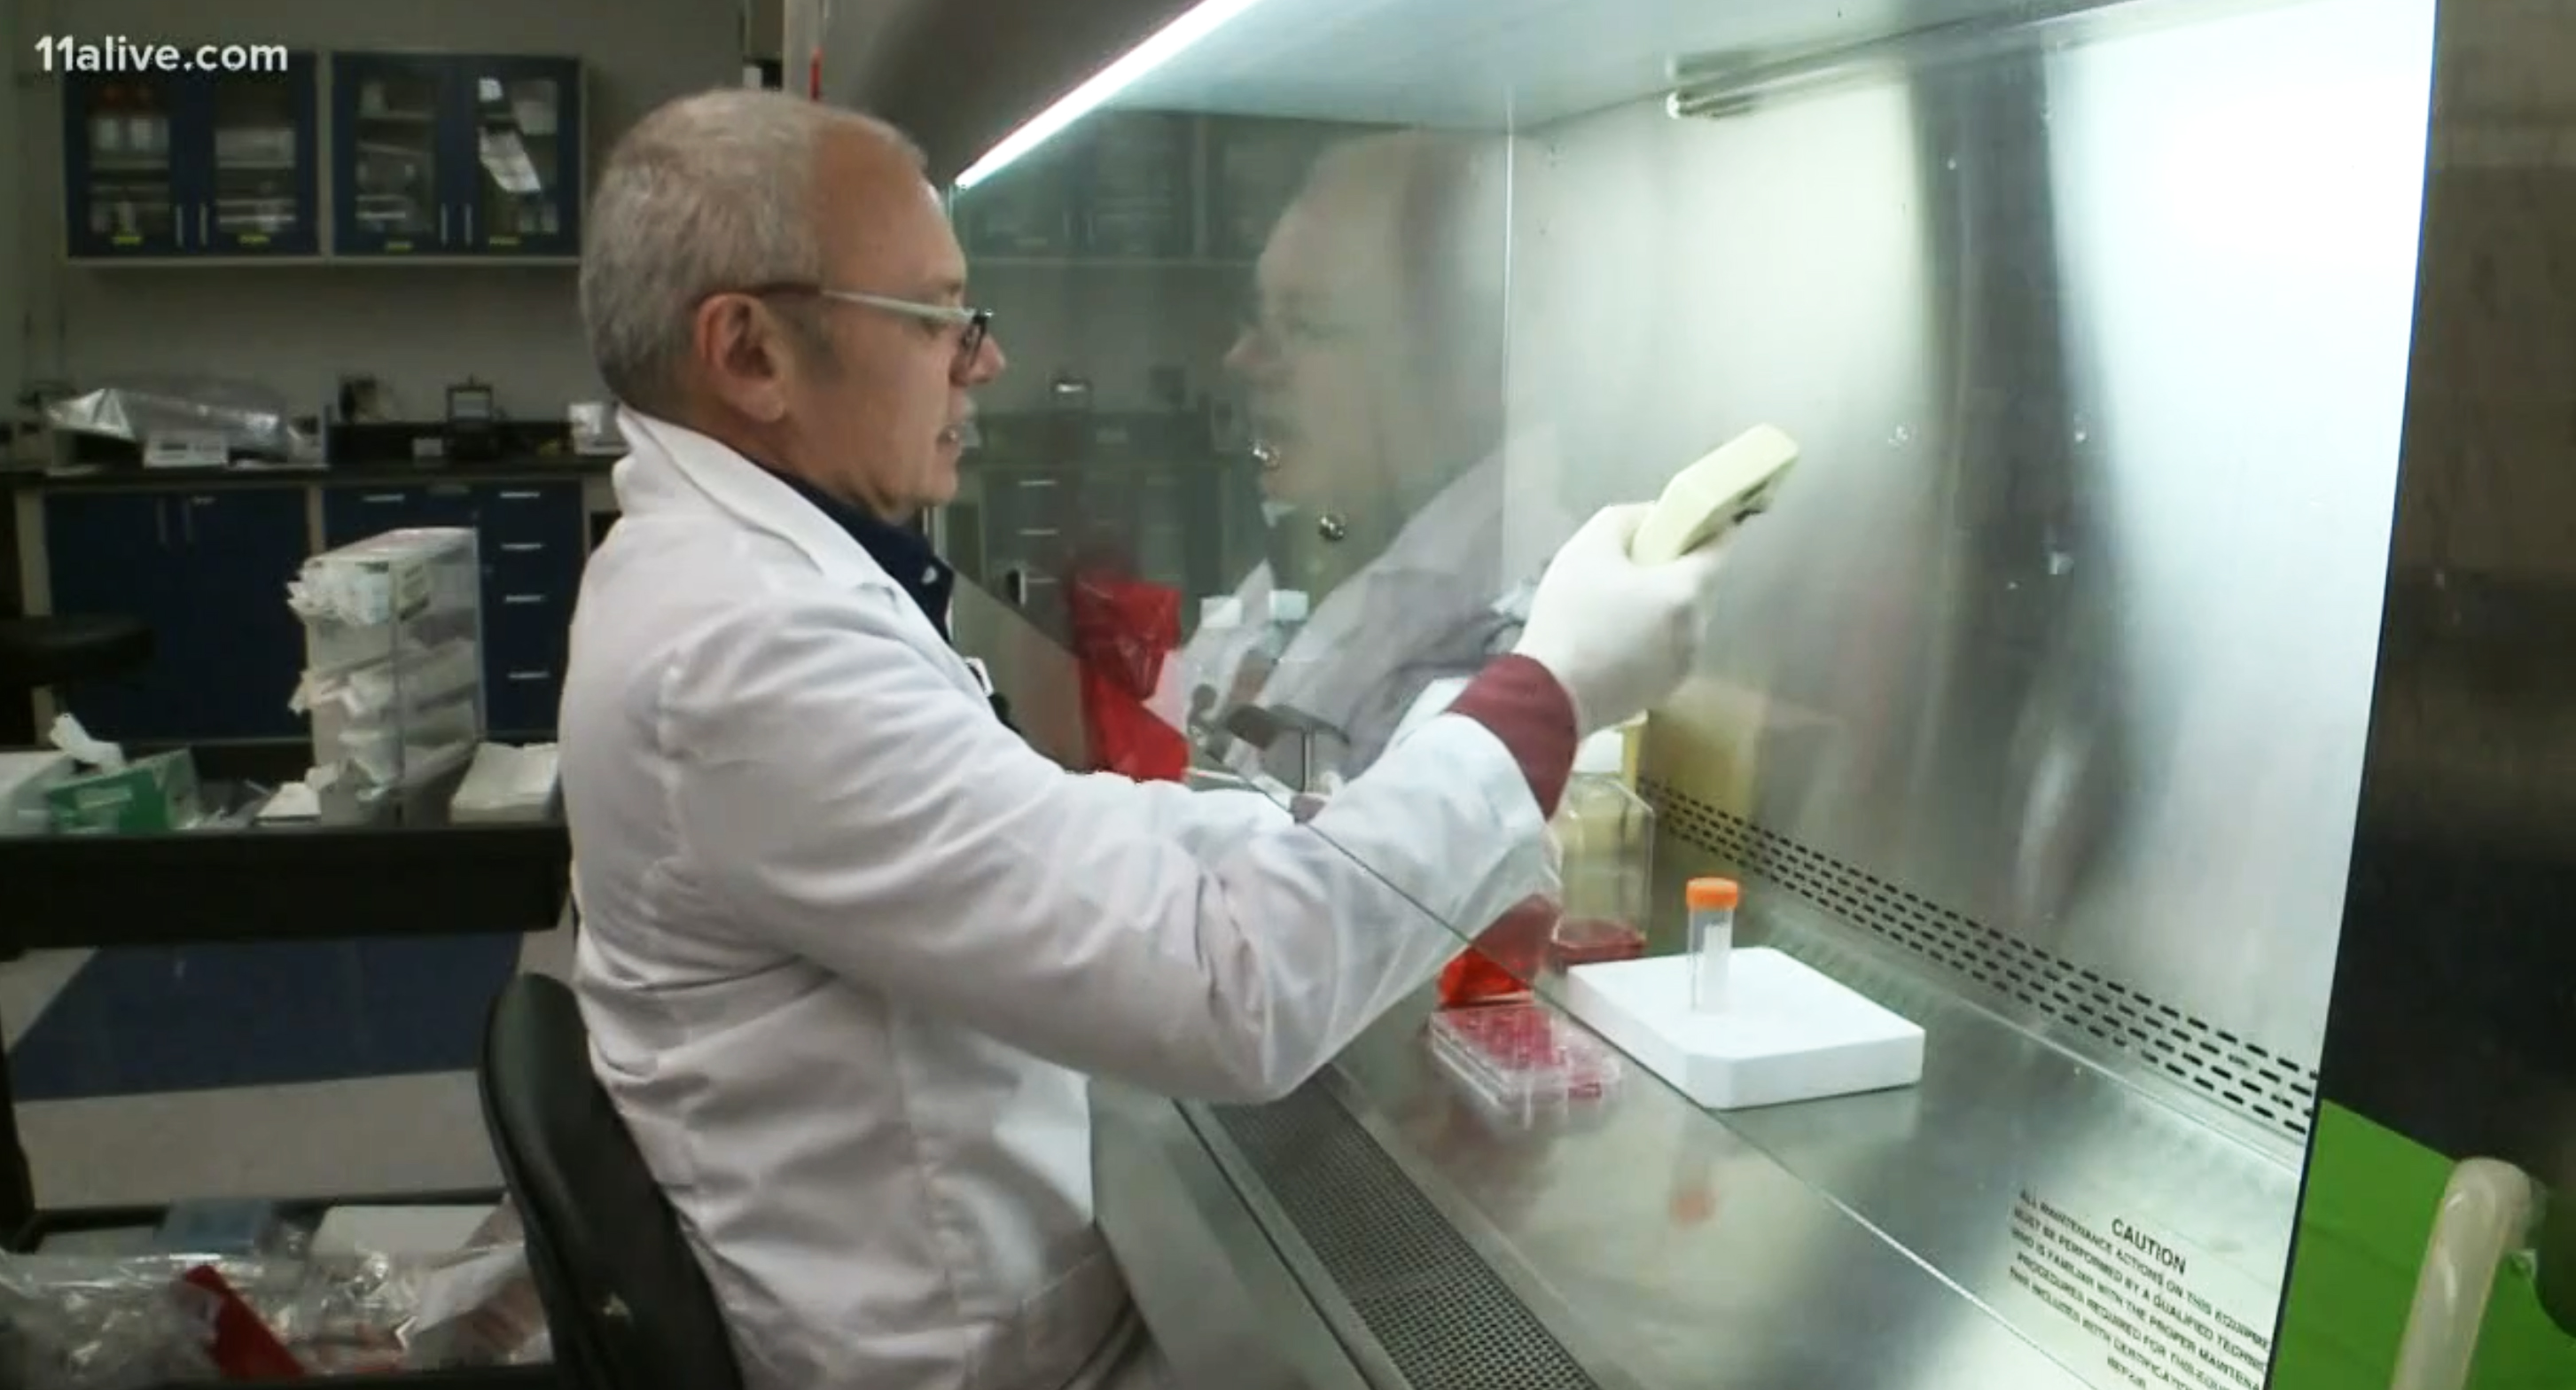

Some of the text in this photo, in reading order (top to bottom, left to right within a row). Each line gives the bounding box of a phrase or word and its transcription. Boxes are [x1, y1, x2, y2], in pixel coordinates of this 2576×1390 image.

[2011, 1227, 2034, 1249] WHO
[2036, 1242, 2045, 1256] IS
[2047, 1249, 2094, 1285] FAMILIAR
[2096, 1281, 2123, 1307] WITH
[2126, 1299, 2145, 1321] THE
[2149, 1316, 2197, 1354] PROPER
[2014, 1206, 2041, 1230] MUST
[2042, 1226, 2055, 1241] BE
[2058, 1234, 2123, 1283] PERFORMED
[2124, 1277, 2140, 1294] BY
[2142, 1288, 2150, 1302] A
[2152, 1293, 2214, 1341] QUALIFIED
[2040, 1202, 2112, 1253] MAINTENANCE
[2116, 1248, 2163, 1286] ACTIONS
[2166, 1280, 2183, 1298] ON
[2186, 1291, 2211, 1316] THIS
[2112, 1218, 2186, 1275] CAUTION
[2087, 1298, 2141, 1340] REQUIRED
[2143, 1335, 2166, 1357] FOR
